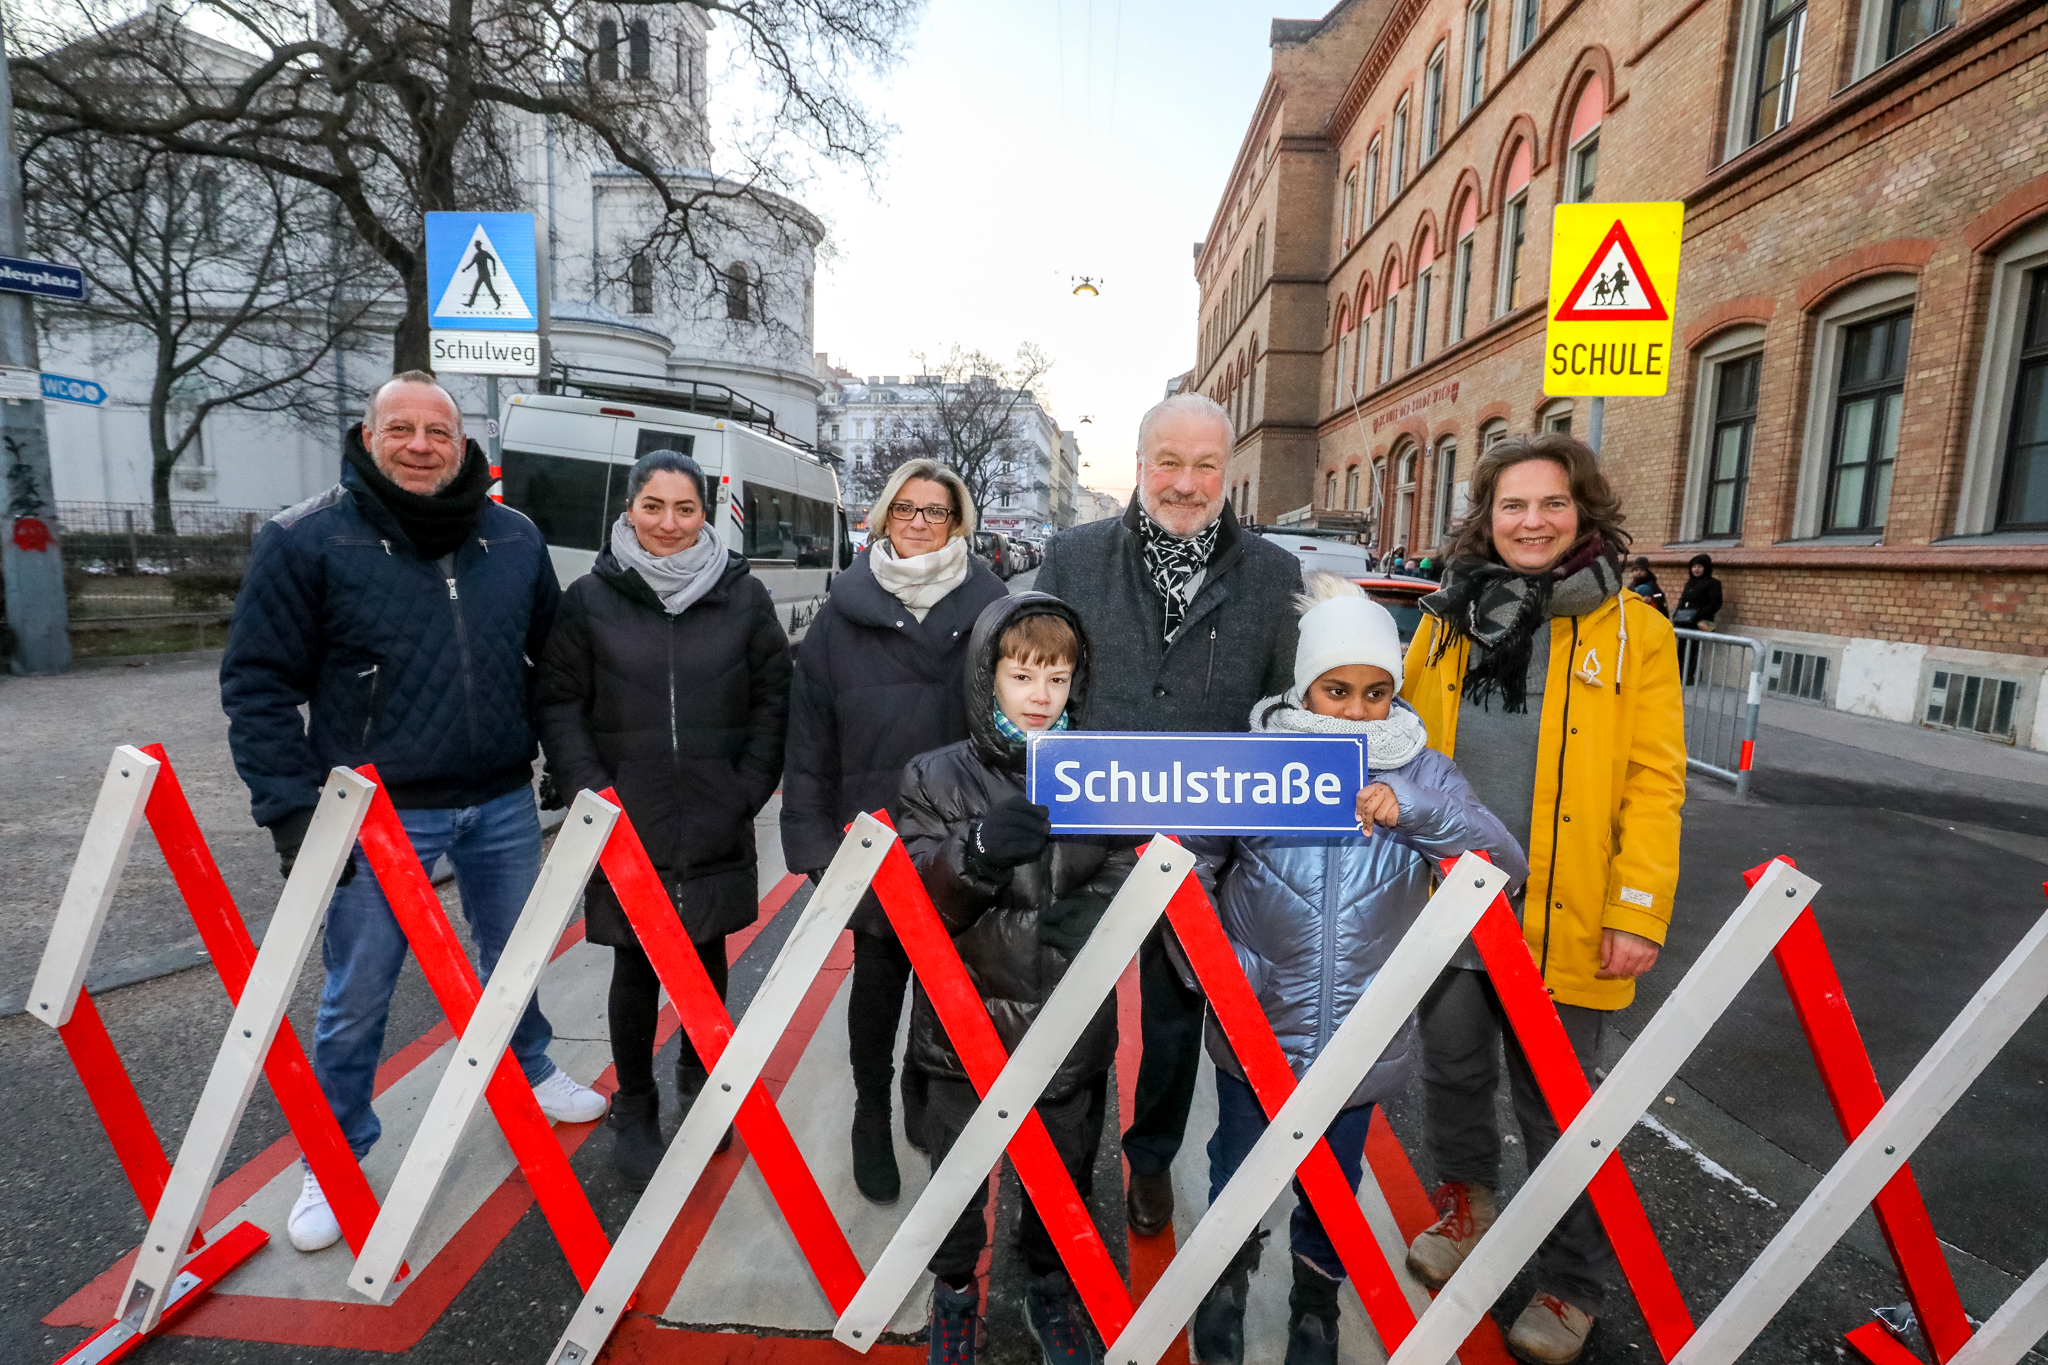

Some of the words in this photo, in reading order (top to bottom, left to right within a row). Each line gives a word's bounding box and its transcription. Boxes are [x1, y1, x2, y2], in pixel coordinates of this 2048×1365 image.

[434, 339, 535, 366] Schulweg
[1552, 343, 1663, 375] SCHULE
[42, 377, 68, 396] WC
[1054, 760, 1341, 805] Schulstraße
